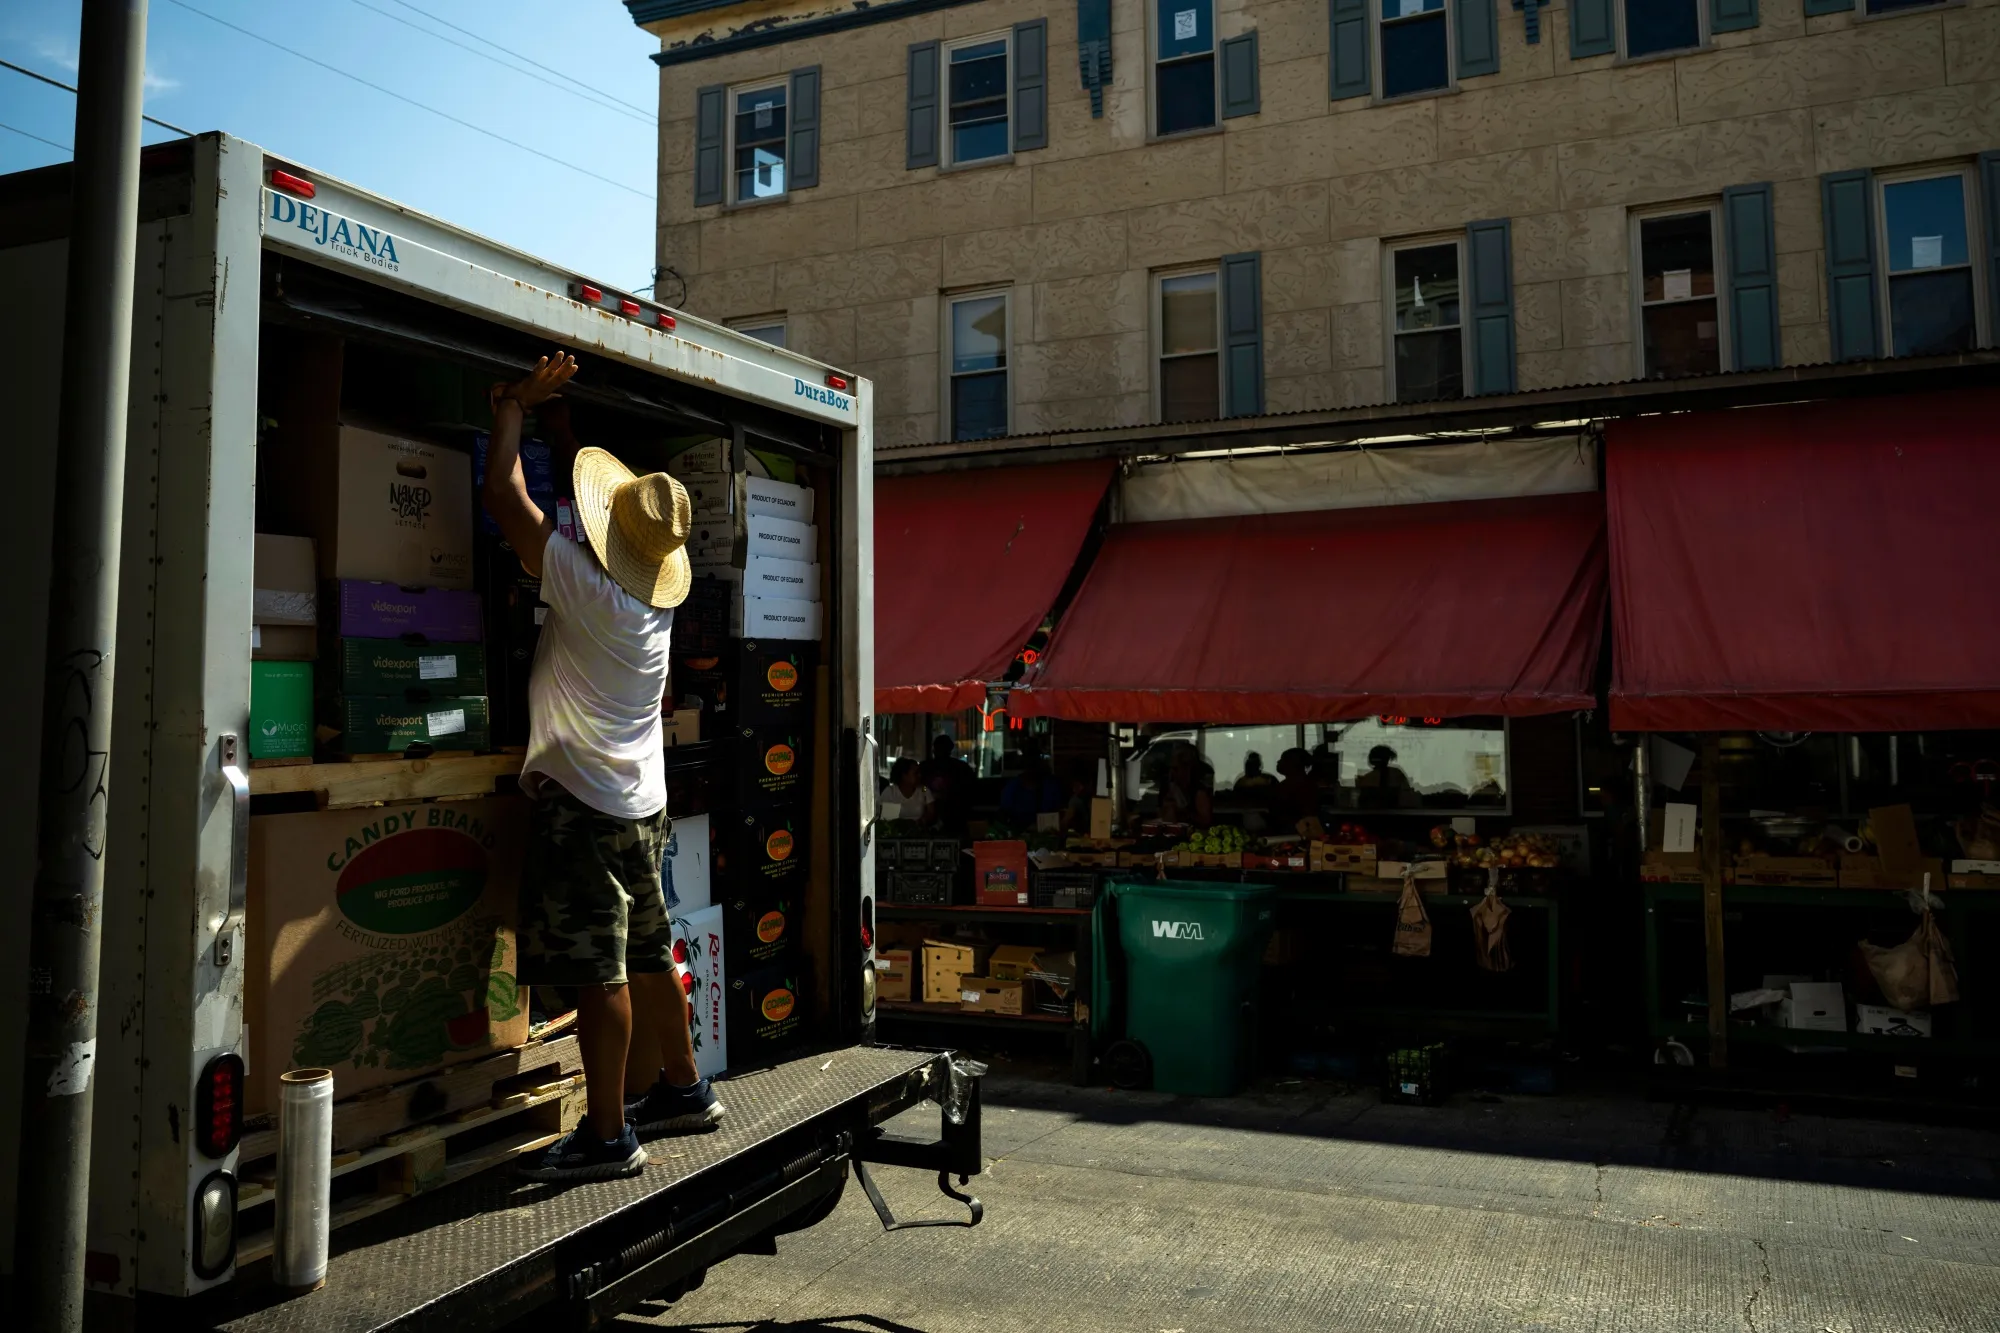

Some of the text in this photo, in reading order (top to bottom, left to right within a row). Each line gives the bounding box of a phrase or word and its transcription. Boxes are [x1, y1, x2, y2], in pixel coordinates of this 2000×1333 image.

[270, 192, 399, 263] DEJANA
[330, 240, 399, 272] Truck Bodies
[794, 378, 849, 411] DuraBox
[695, 452, 715, 460] Monte
[389, 482, 432, 507] NAKED
[751, 493, 771, 503] PRODUCT
[777, 498, 796, 507] ECUADOR
[399, 500, 425, 522] leaf
[395, 520, 426, 530] LETTUCE
[758, 532, 776, 541] PRODUCT
[783, 535, 801, 545] ECUADOR
[762, 574, 780, 582] PRODUCT
[786, 576, 804, 584] ECUADOR
[370, 599, 417, 614] videxport
[763, 614, 782, 622] PRODUCT
[373, 655, 419, 670] videxport
[277, 720, 308, 732] Mucci
[376, 713, 423, 727] videxport
[398, 729, 416, 737] Grapes
[758, 776, 781, 784] PREMIUM
[327, 808, 496, 872] CANDY BRAND
[374, 890, 388, 900] MG
[389, 887, 411, 898] FORD
[387, 892, 450, 908] PRODUCE OF USA
[335, 900, 485, 950] FERTILIZED WITH HONEY
[1152, 920, 1204, 940] WM
[708, 932, 721, 1042] RED CHIEF
[756, 1022, 781, 1034] PREMIUM
